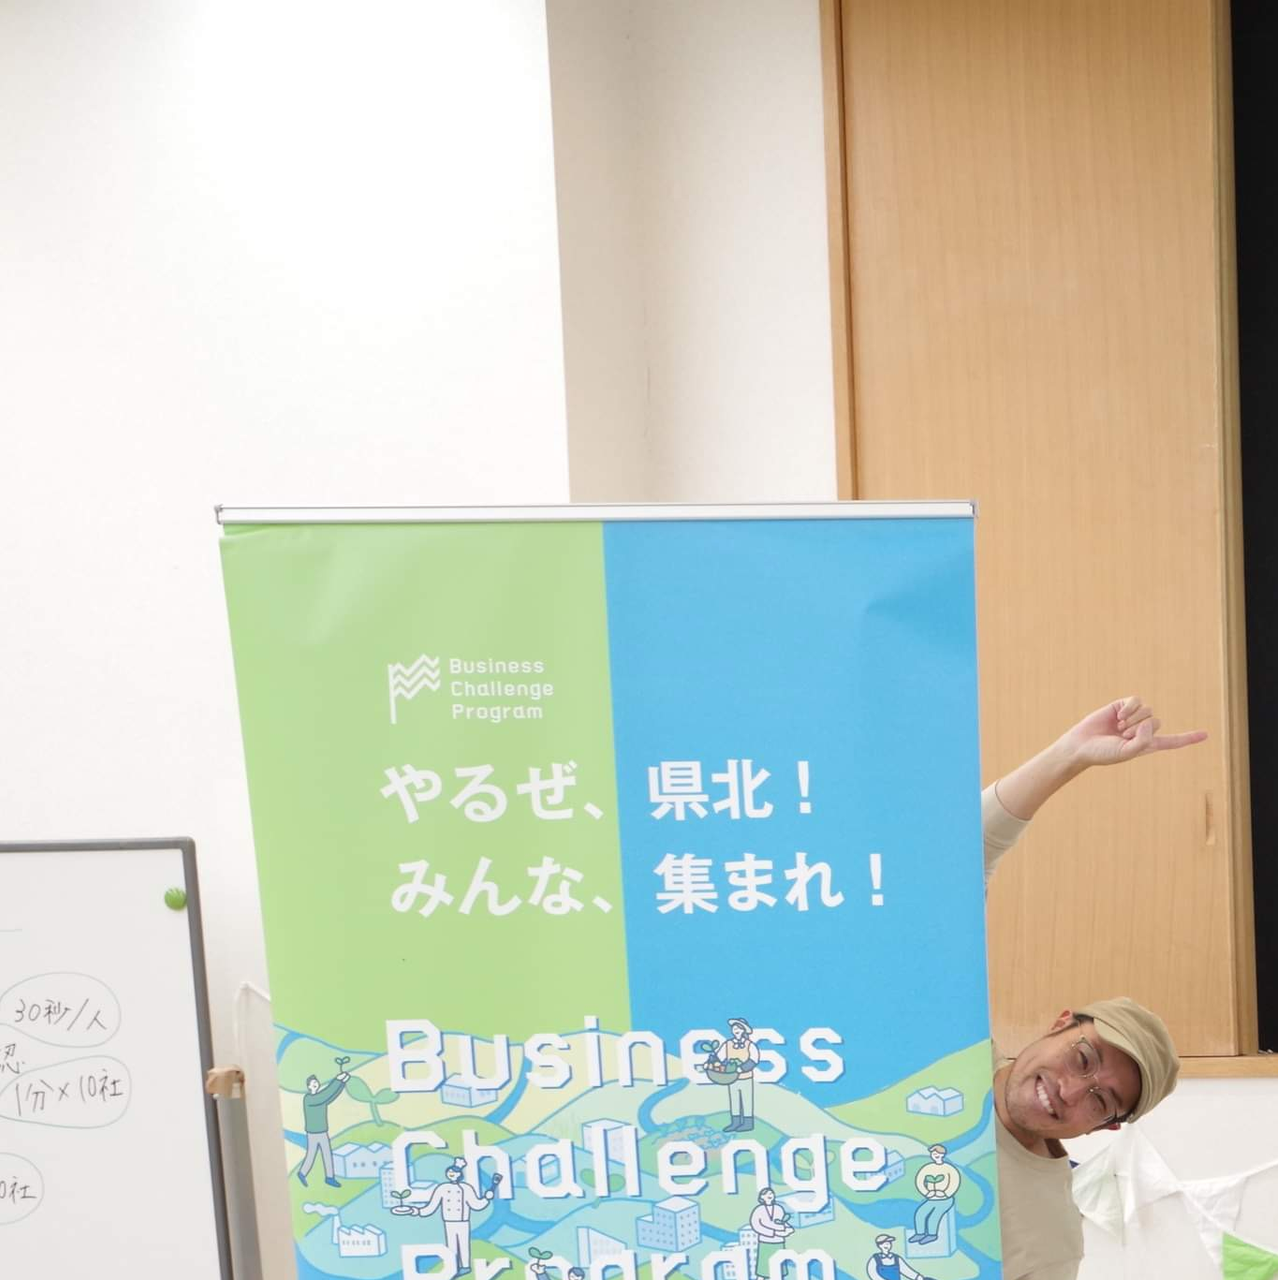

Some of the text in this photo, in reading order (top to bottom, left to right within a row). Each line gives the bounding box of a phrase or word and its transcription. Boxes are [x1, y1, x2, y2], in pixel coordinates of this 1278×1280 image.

[449, 657, 545, 675] Business
[450, 680, 554, 699] Challenge
[452, 704, 544, 723] Program
[386, 1015, 846, 1093] Business
[390, 1125, 889, 1214] Challenge
